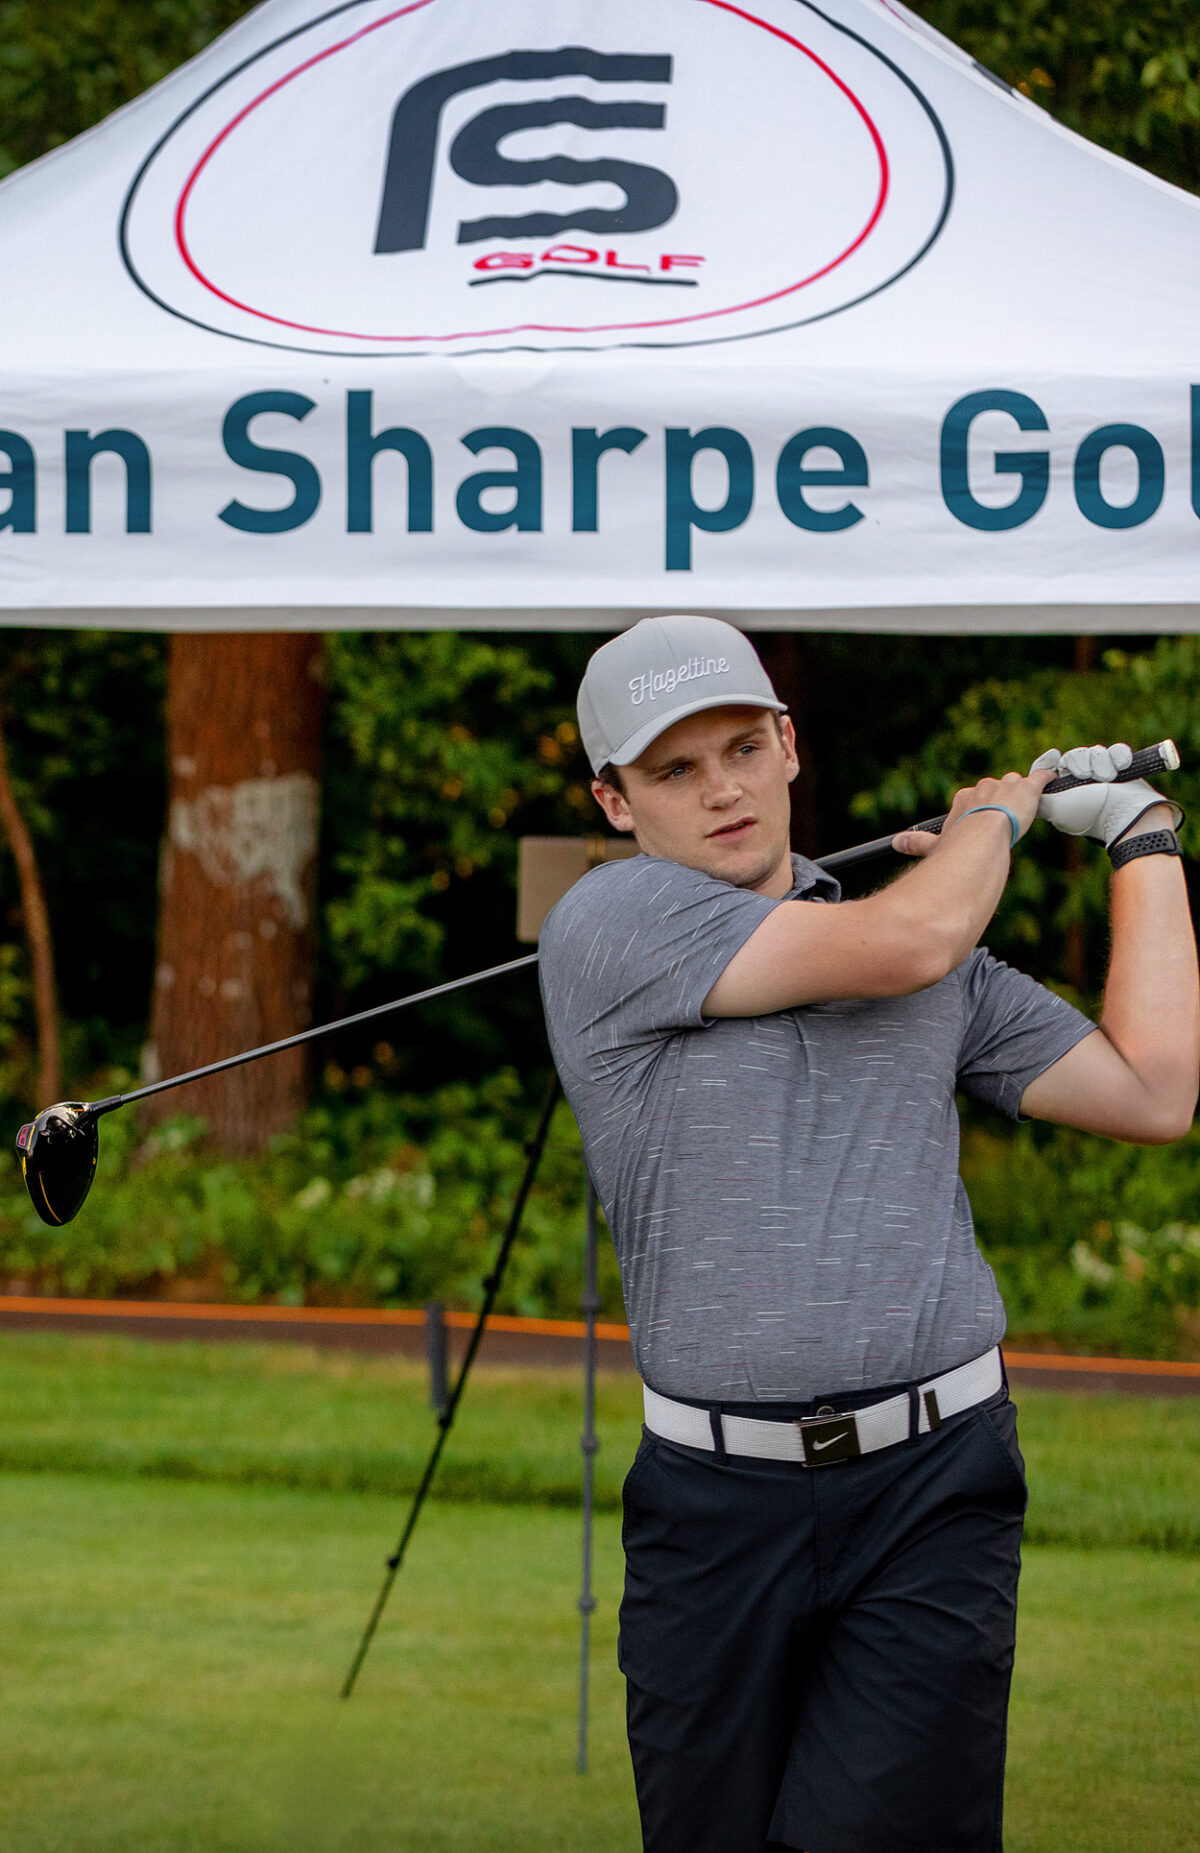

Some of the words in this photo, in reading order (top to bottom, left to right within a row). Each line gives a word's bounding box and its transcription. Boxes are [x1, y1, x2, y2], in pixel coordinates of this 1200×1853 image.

[472, 244, 706, 272] GOLF
[217, 388, 870, 572] Sharpe
[628, 656, 731, 706] Hazeltine
